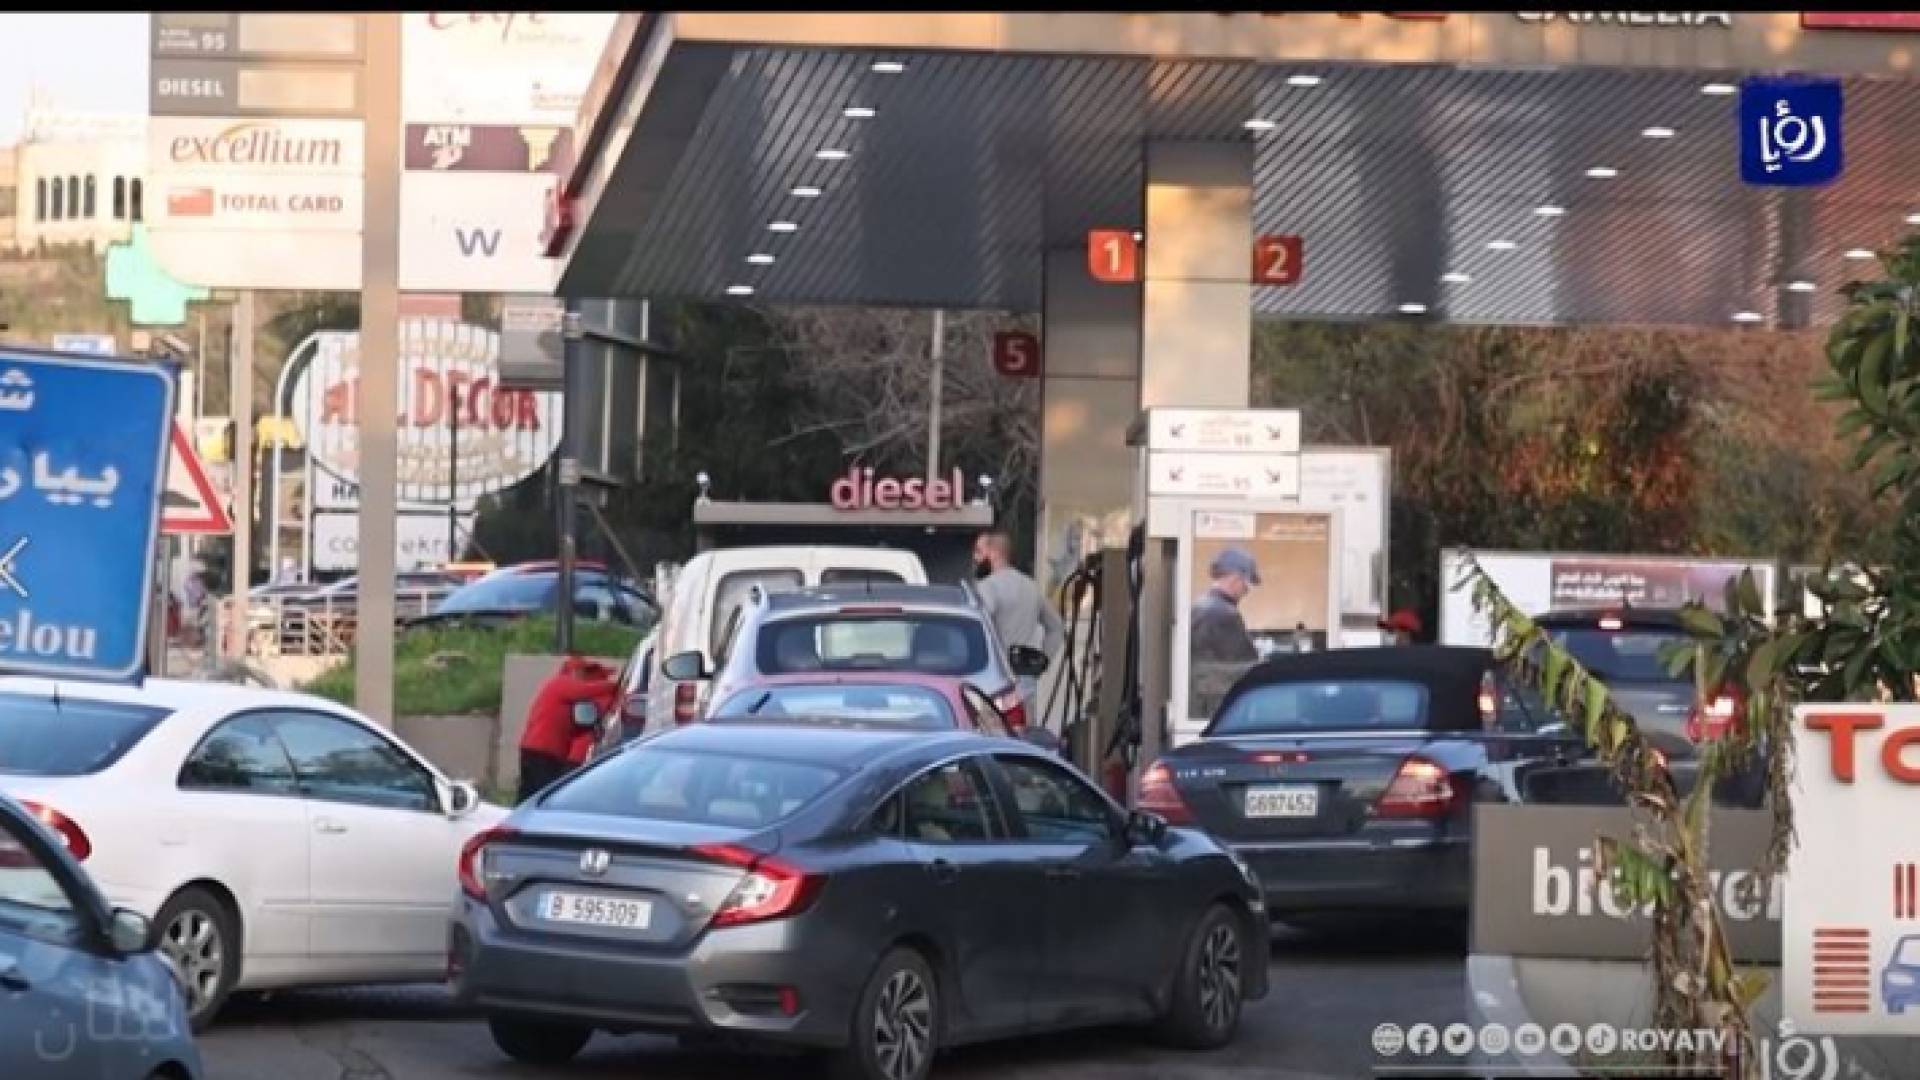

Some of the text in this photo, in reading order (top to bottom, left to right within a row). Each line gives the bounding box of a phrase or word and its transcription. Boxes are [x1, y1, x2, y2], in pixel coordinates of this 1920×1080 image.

[158, 79, 224, 96] DIESEL
[169, 128, 342, 165] excellium
[423, 126, 471, 147] ATM
[220, 194, 344, 212] TOTAL CARD
[1102, 237, 1123, 274] 1
[1265, 244, 1290, 280] 2
[1005, 339, 1026, 371] 5
[412, 366, 541, 432] DECOR
[831, 466, 964, 511] diesel
[576, 898, 642, 925] 595309
